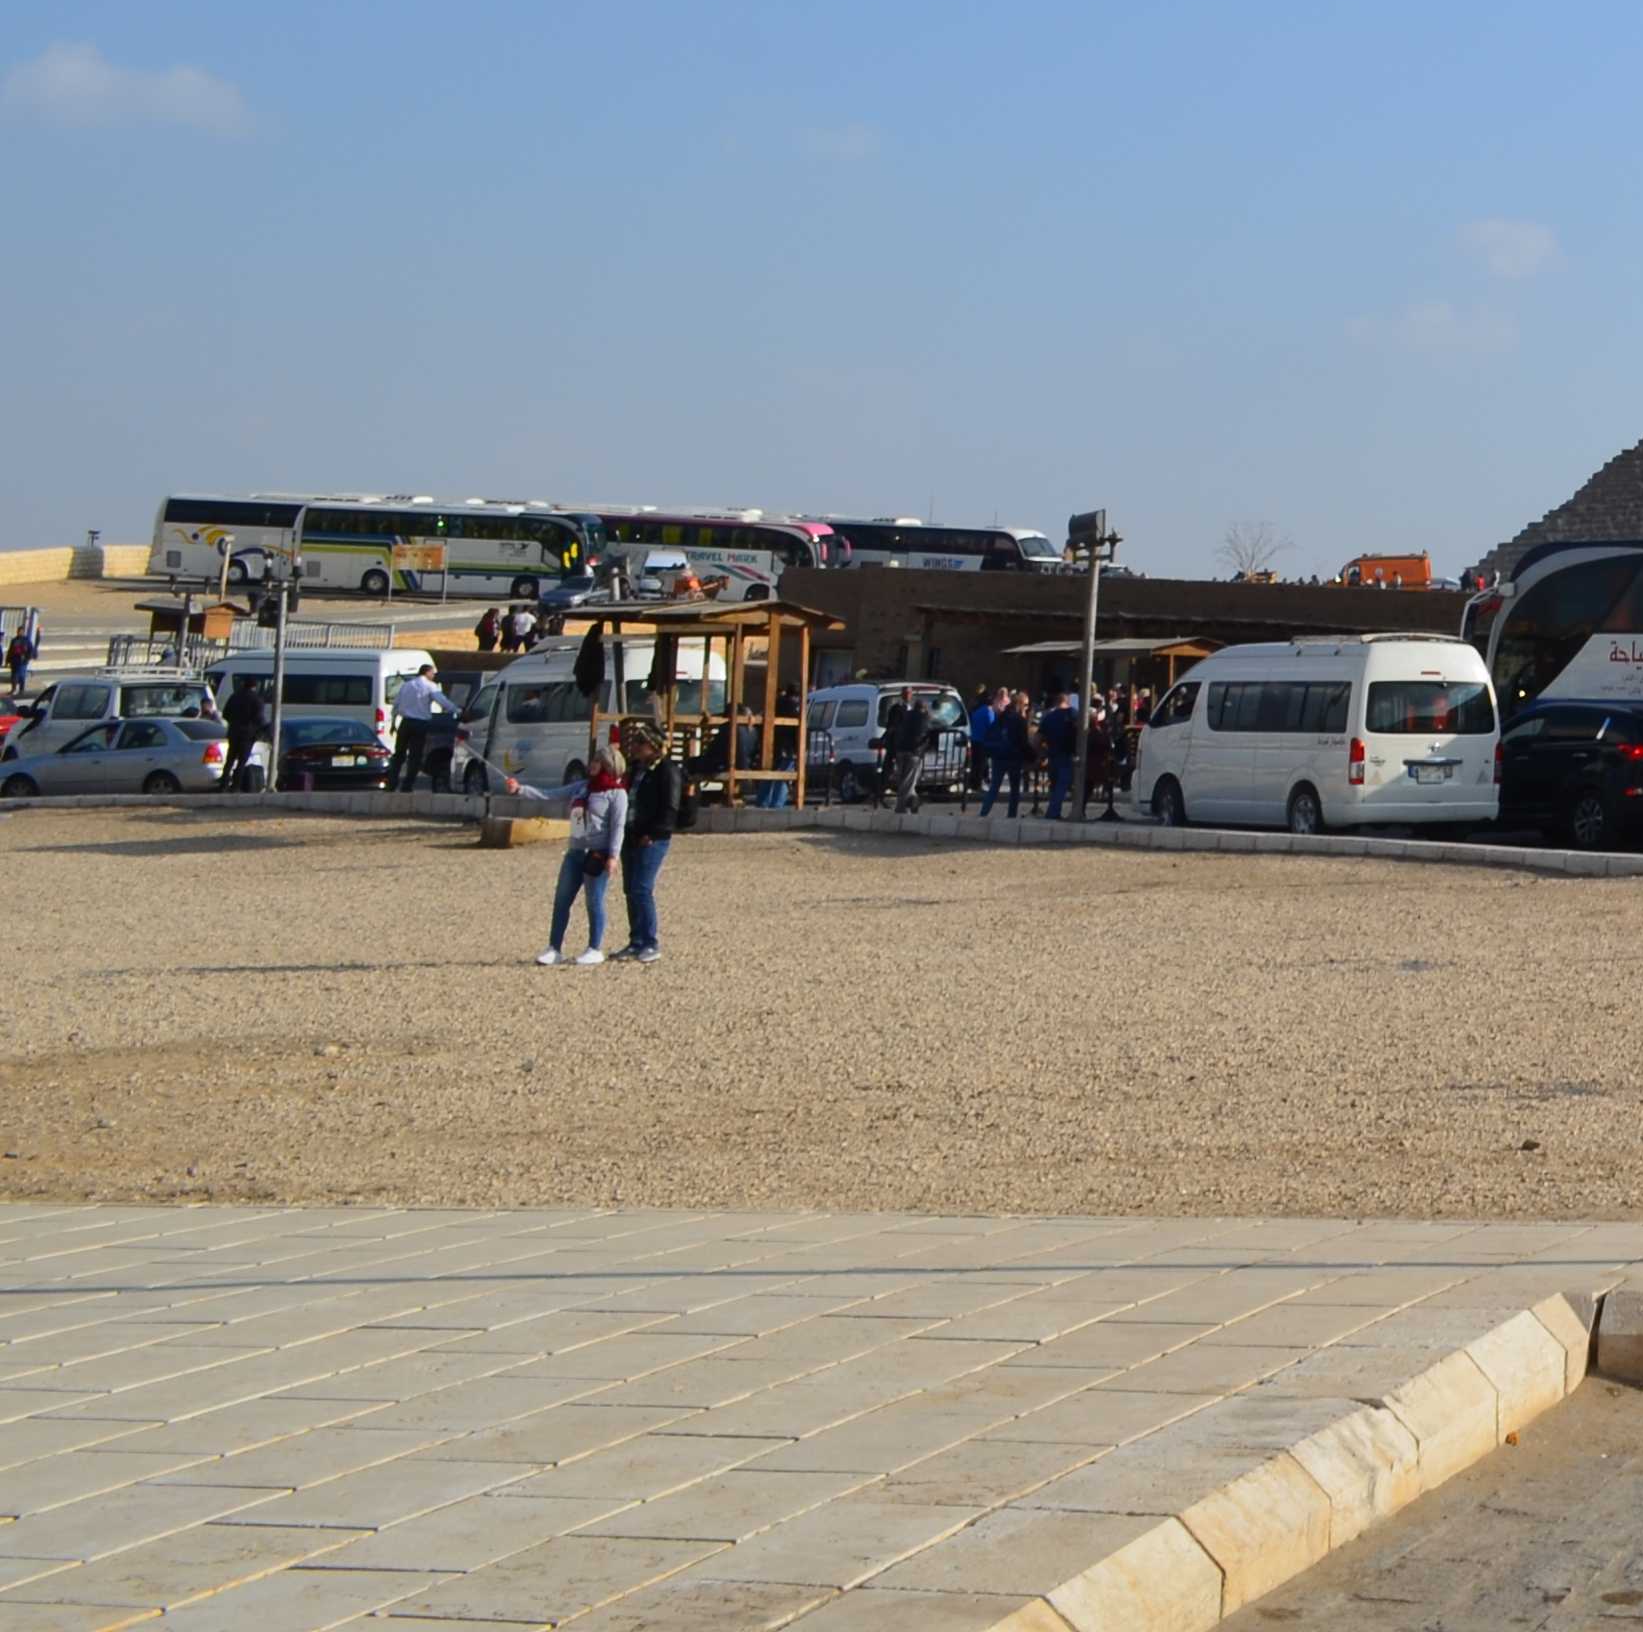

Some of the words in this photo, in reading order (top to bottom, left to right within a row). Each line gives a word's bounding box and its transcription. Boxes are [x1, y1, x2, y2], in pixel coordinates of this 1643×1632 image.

[685, 551, 723, 563] TRAVEL
[727, 553, 758, 564] MARK
[923, 558, 953, 569] WINGS
